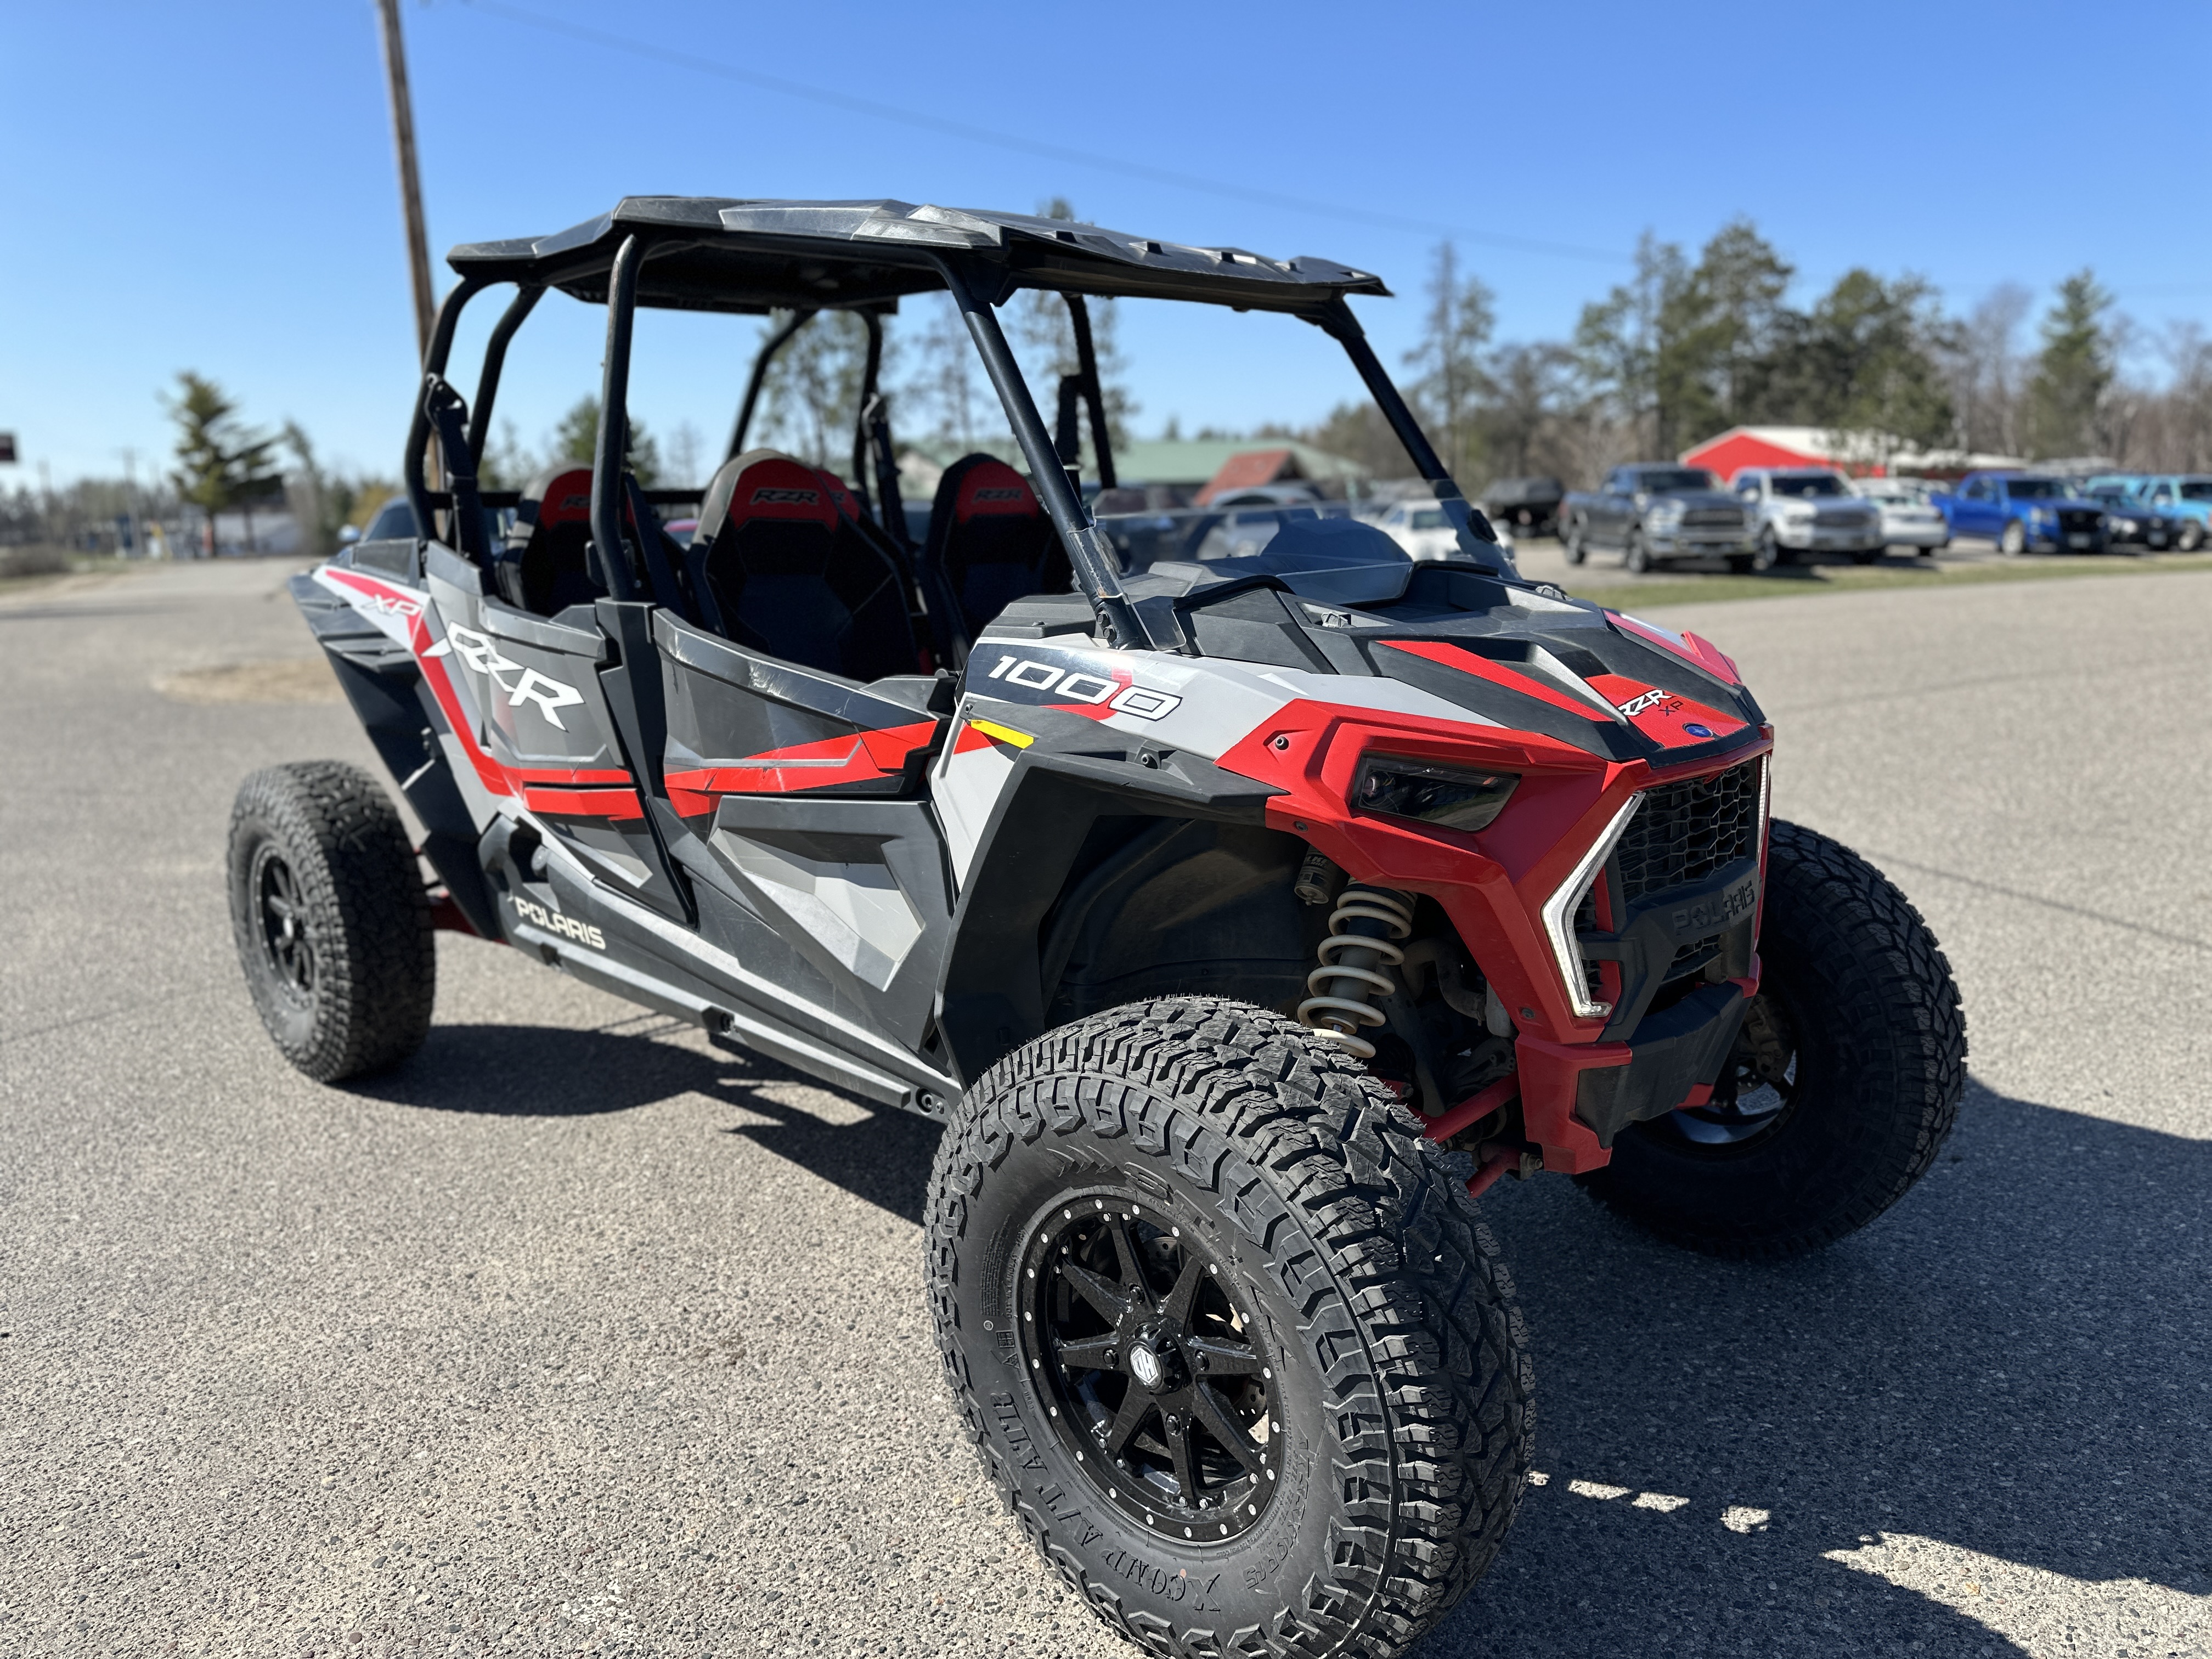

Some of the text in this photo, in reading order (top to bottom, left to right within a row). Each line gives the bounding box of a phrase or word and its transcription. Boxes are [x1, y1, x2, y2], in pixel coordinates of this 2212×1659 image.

[557, 494, 590, 511] RZ
[749, 487, 821, 505] RZR
[971, 487, 1024, 505] RZR
[360, 594, 422, 616] XP
[422, 621, 584, 731] RZR
[989, 655, 1183, 721] 1000
[1618, 690, 1672, 716] RZR
[1658, 701, 1684, 716] XP
[515, 898, 606, 950] POLARIS
[1672, 880, 1755, 936] POLARIS
[989, 1390, 1050, 1474] ATR
[1034, 1482, 1105, 1550] A/T
[1101, 1546, 1187, 1601] COMP
